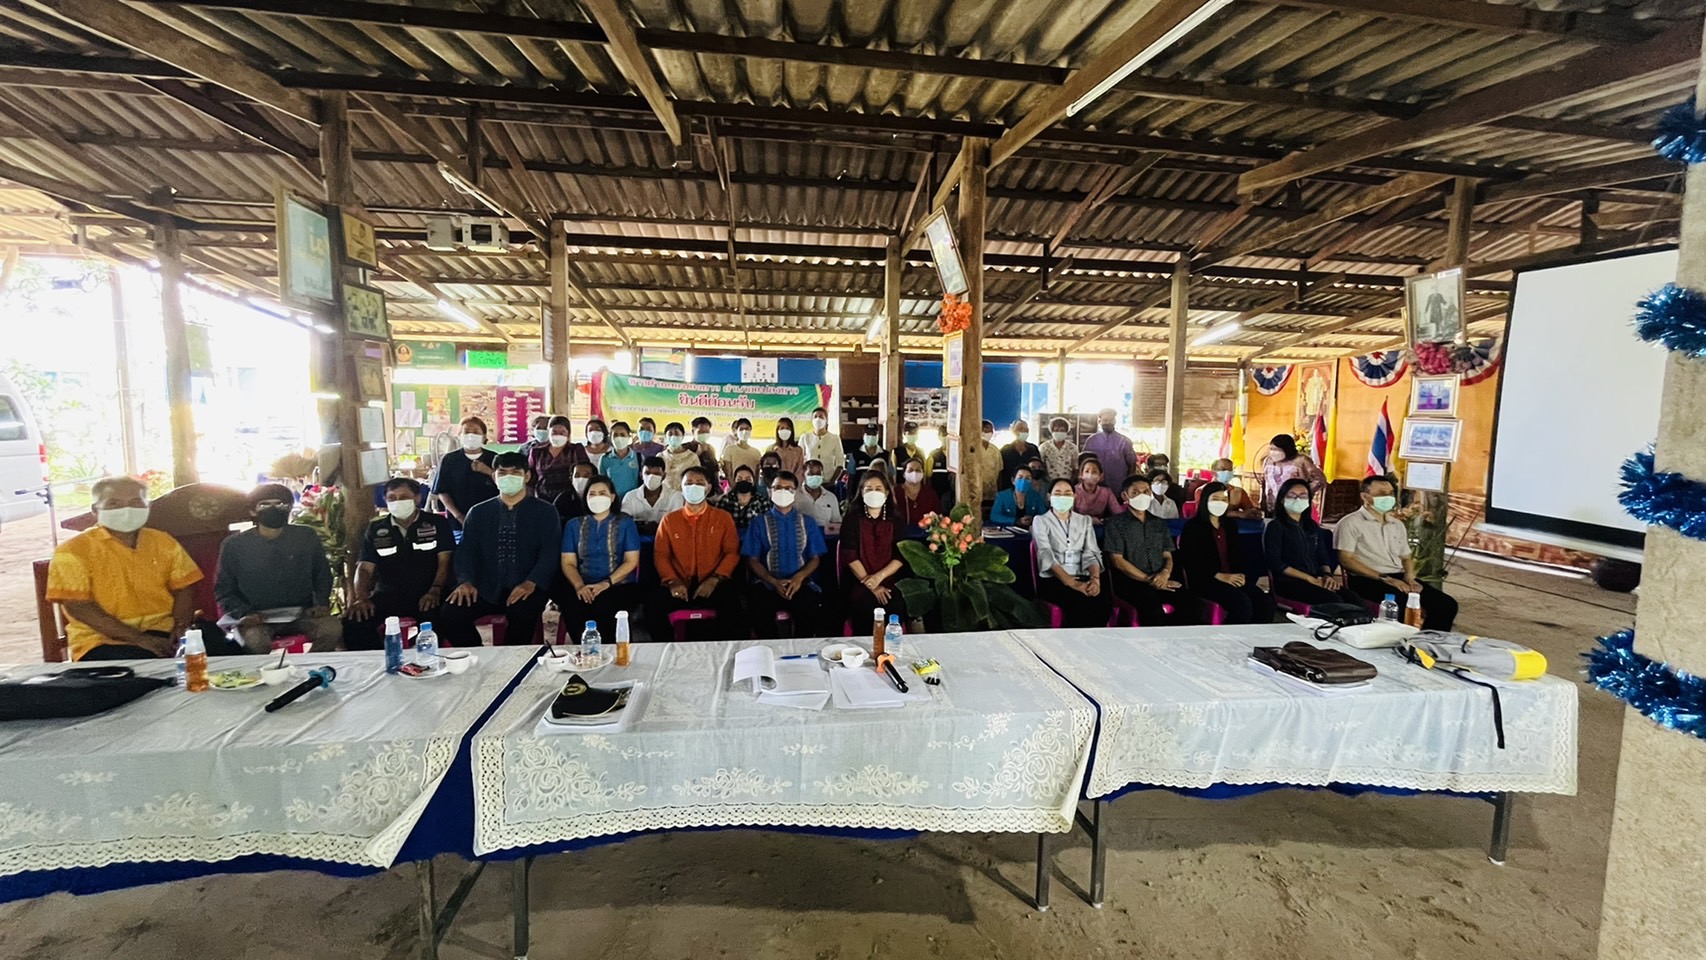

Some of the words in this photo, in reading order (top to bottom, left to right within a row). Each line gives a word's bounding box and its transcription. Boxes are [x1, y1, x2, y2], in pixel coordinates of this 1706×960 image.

[679, 393, 755, 409] ยินดีต้อนรับ
